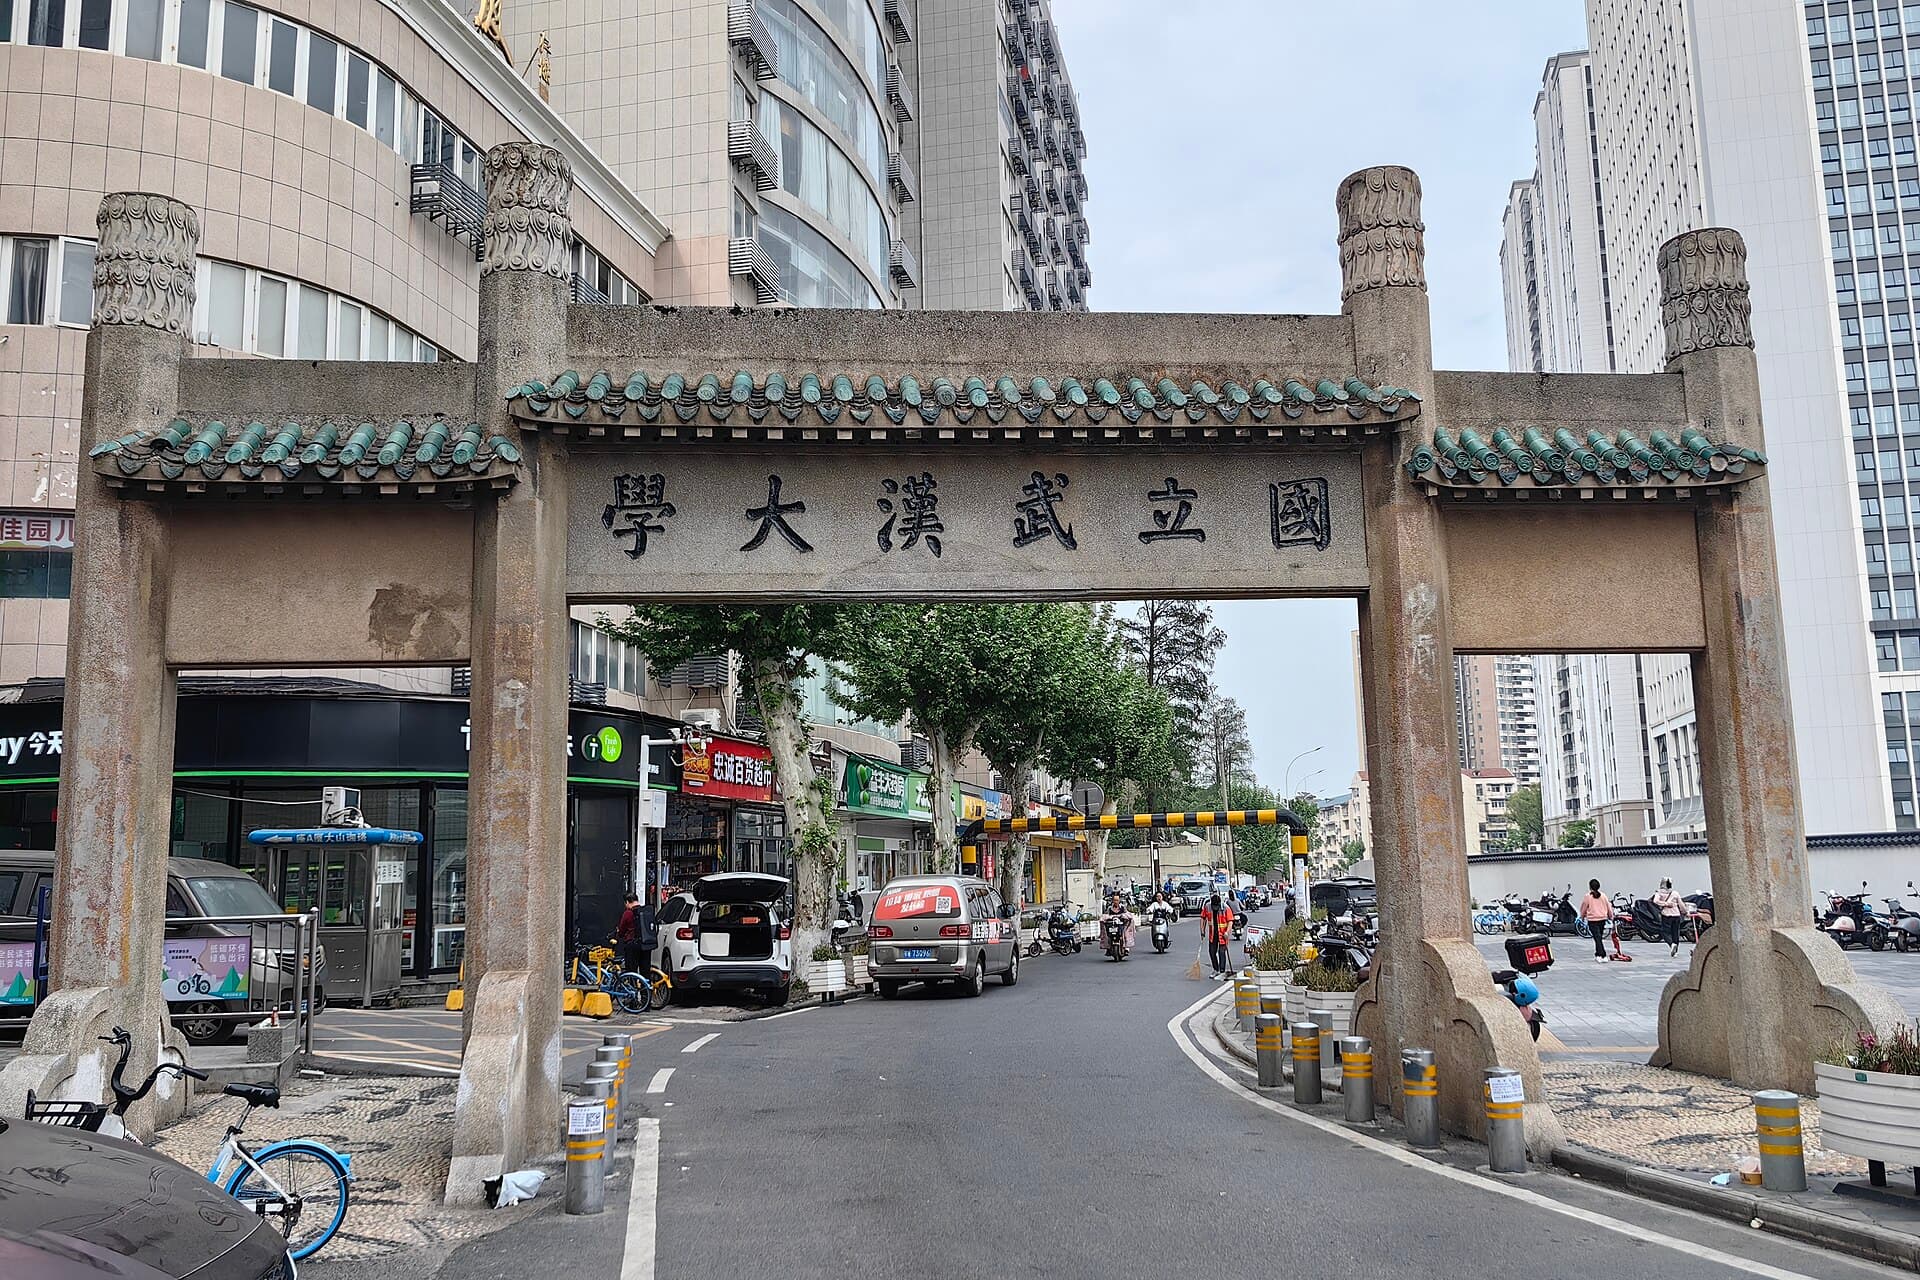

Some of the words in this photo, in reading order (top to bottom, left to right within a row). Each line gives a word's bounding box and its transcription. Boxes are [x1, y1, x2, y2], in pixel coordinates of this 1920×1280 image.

[713, 750, 772, 788] 忠诚百货超市
